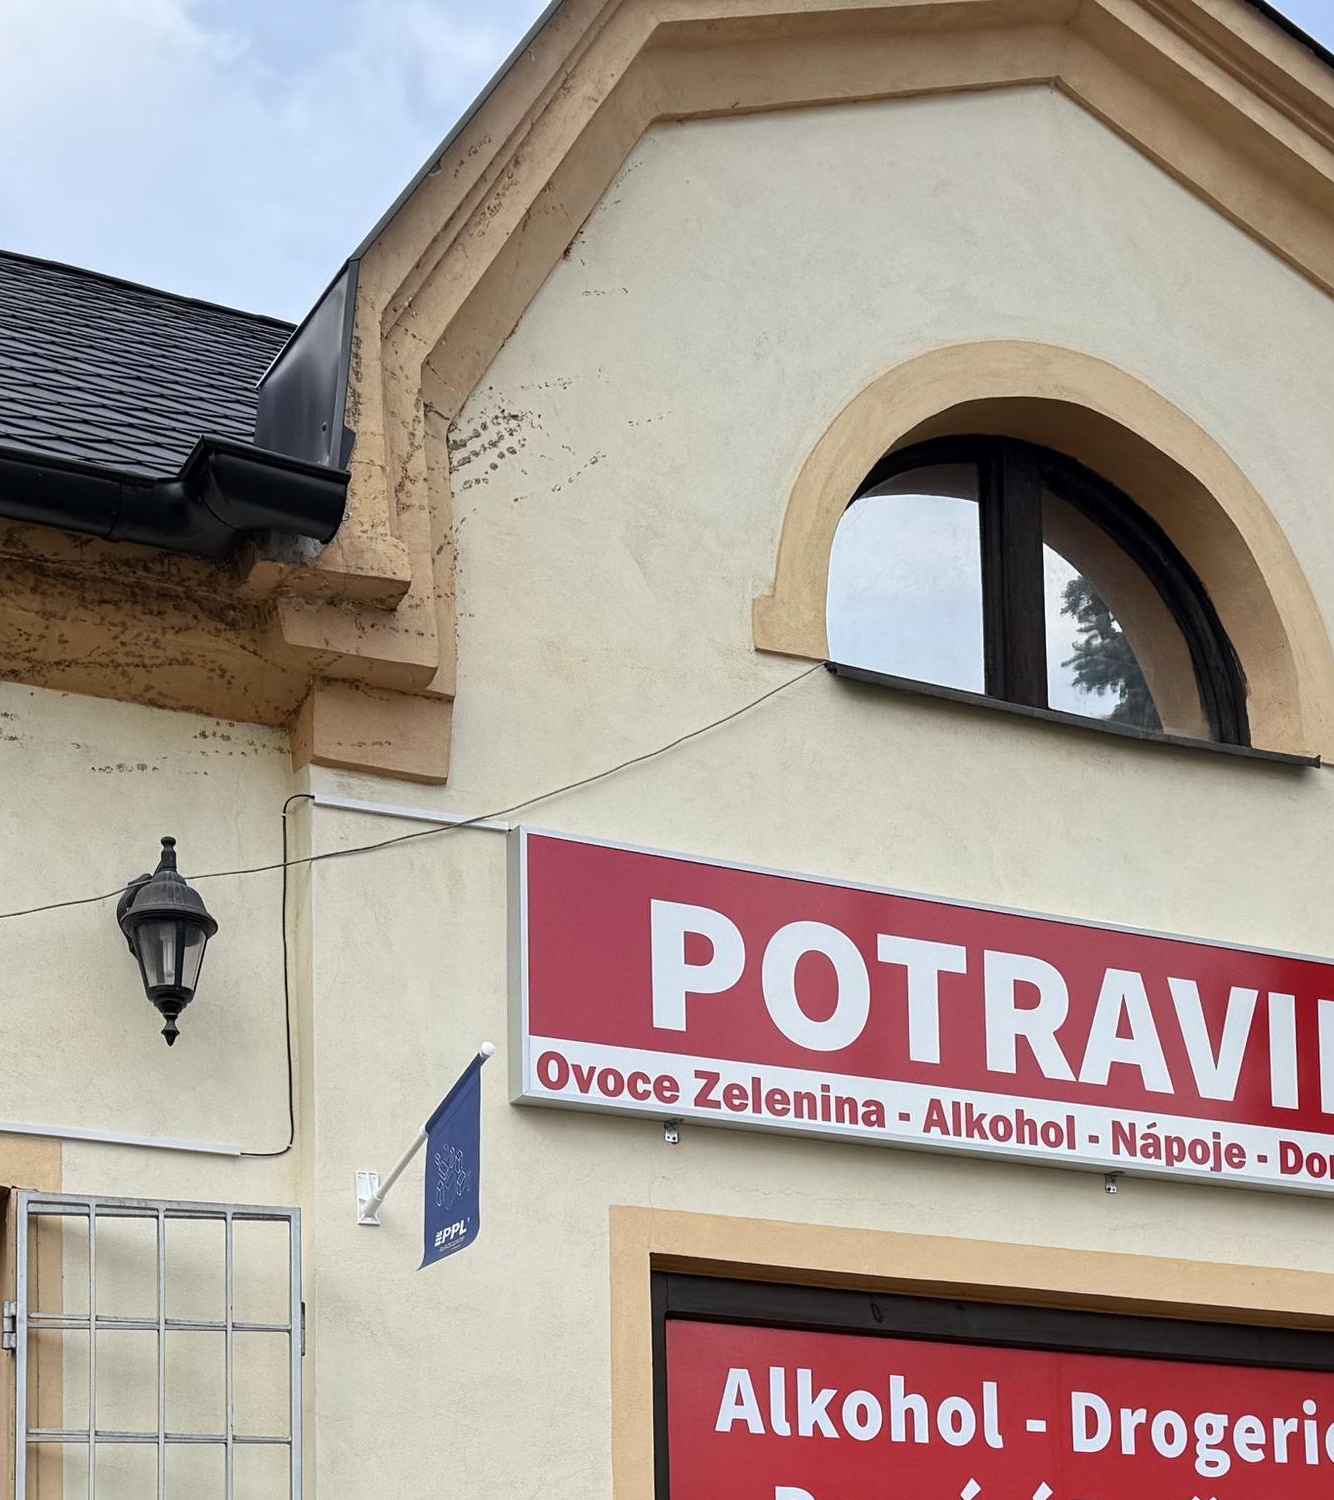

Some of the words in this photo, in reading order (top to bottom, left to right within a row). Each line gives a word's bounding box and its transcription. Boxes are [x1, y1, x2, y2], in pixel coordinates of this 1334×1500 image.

[537, 1050, 679, 1104] Ovoce
[694, 1070, 886, 1128] Zelenina
[922, 1098, 1077, 1150] Alkohol
[1110, 1120, 1247, 1172] Nápoje
[442, 1219, 467, 1243] PPL
[714, 1365, 1004, 1450] Alkohol
